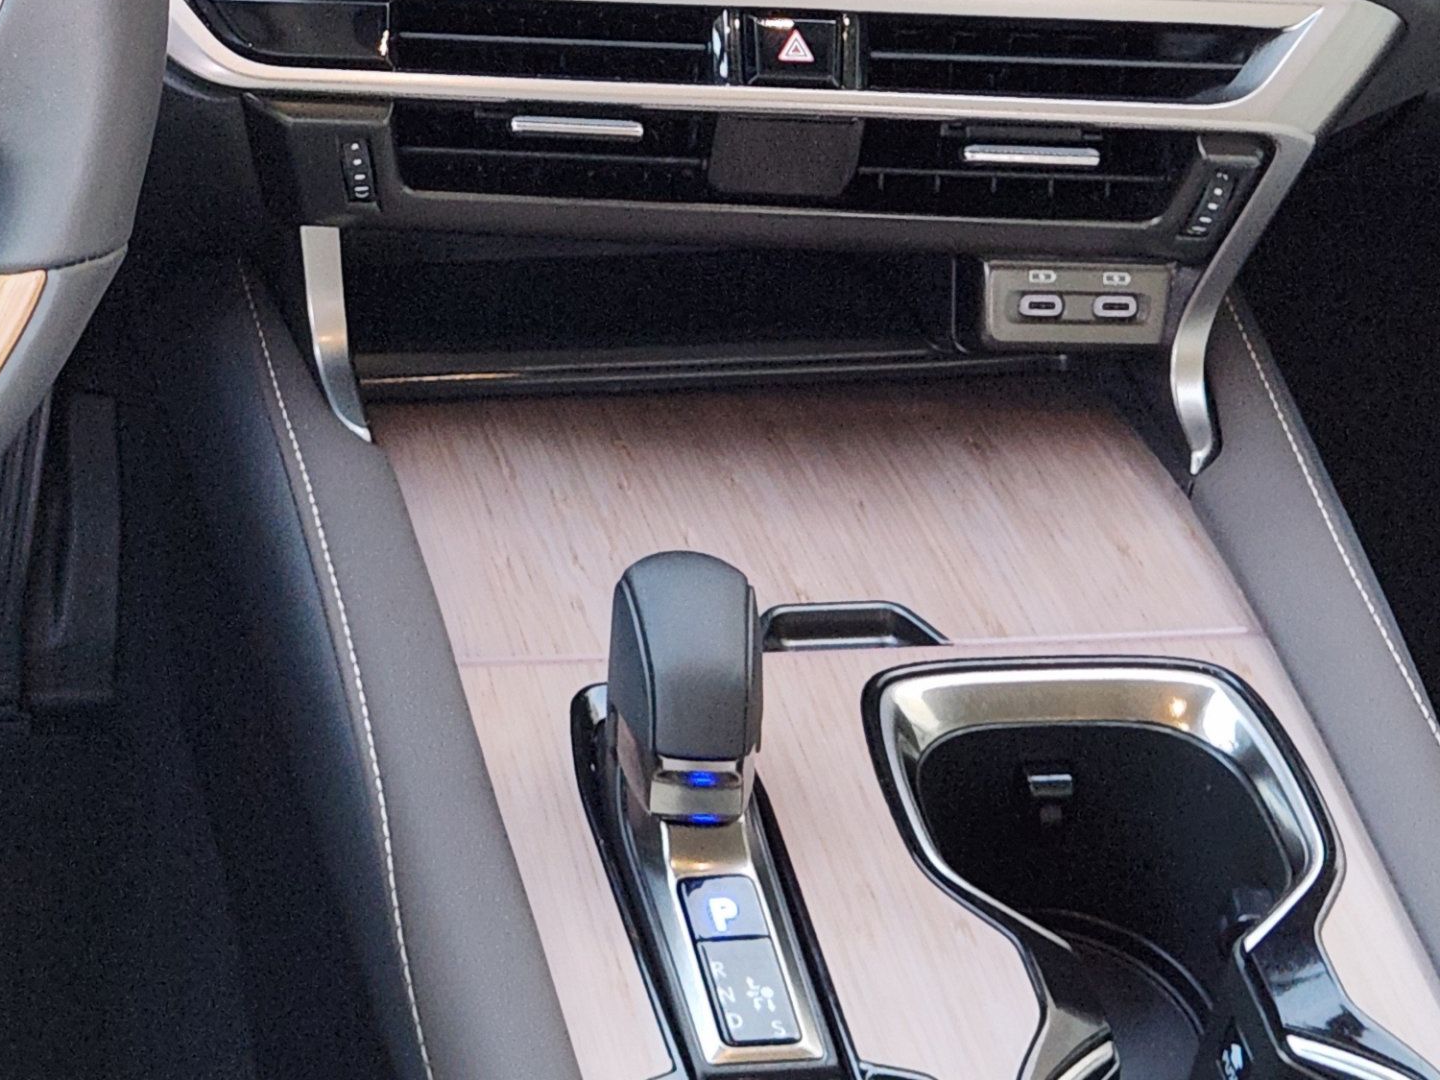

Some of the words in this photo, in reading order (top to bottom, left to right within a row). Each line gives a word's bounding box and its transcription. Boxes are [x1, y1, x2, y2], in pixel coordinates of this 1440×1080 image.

[708, 896, 739, 932] P
[710, 960, 727, 980] R
[716, 985, 736, 1005] N
[728, 1012, 744, 1030] D
[770, 1020, 787, 1038] S
